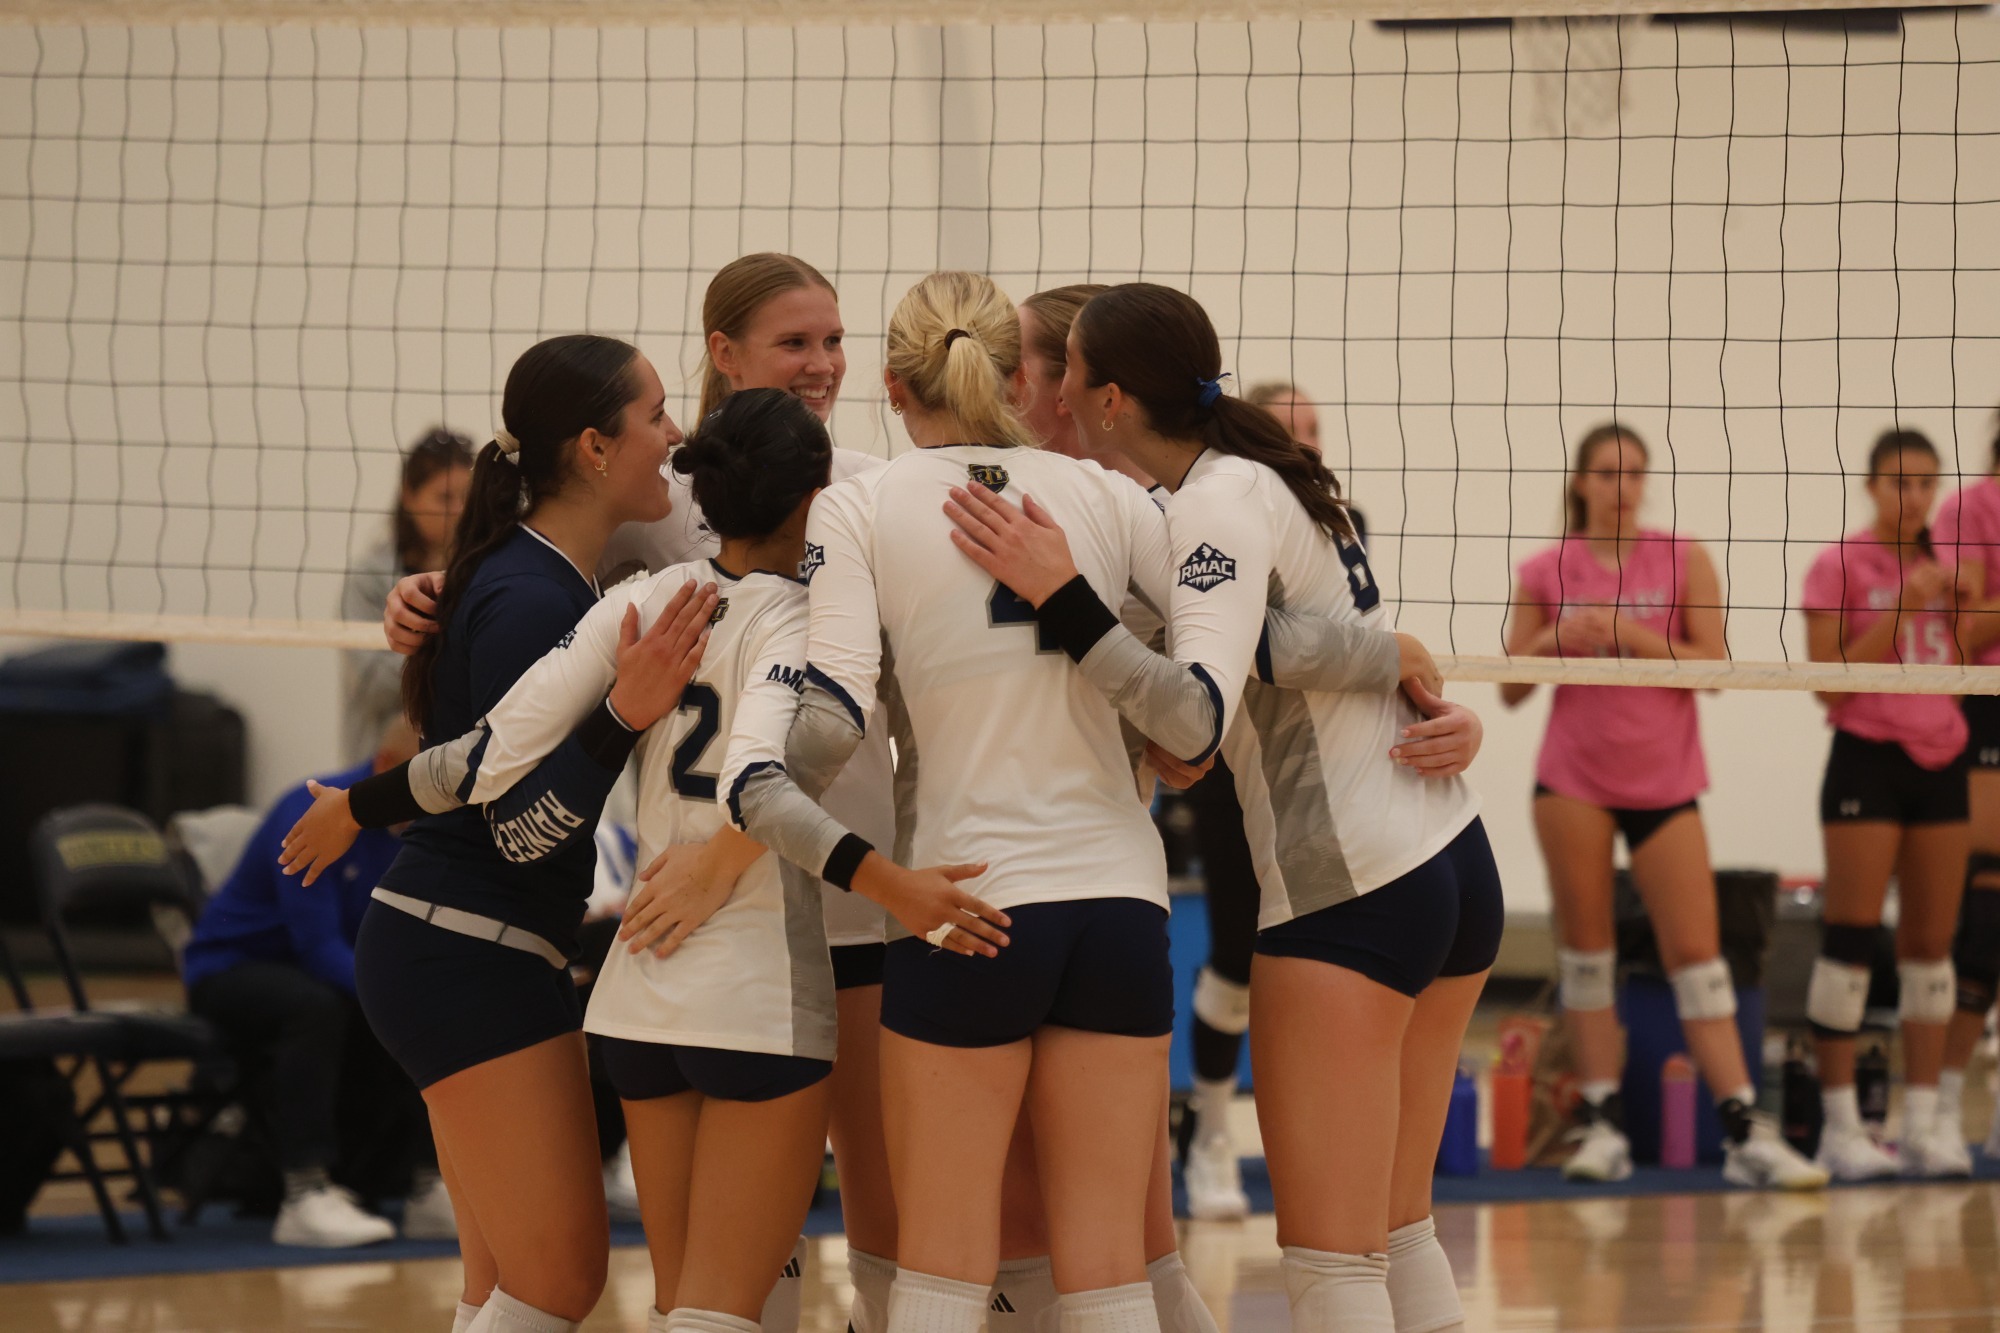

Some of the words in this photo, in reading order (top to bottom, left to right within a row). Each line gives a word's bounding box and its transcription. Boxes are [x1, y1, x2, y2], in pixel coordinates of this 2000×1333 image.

[1180, 560, 1234, 584] RMAC
[1904, 617, 1949, 664] 15
[667, 681, 722, 804] 2
